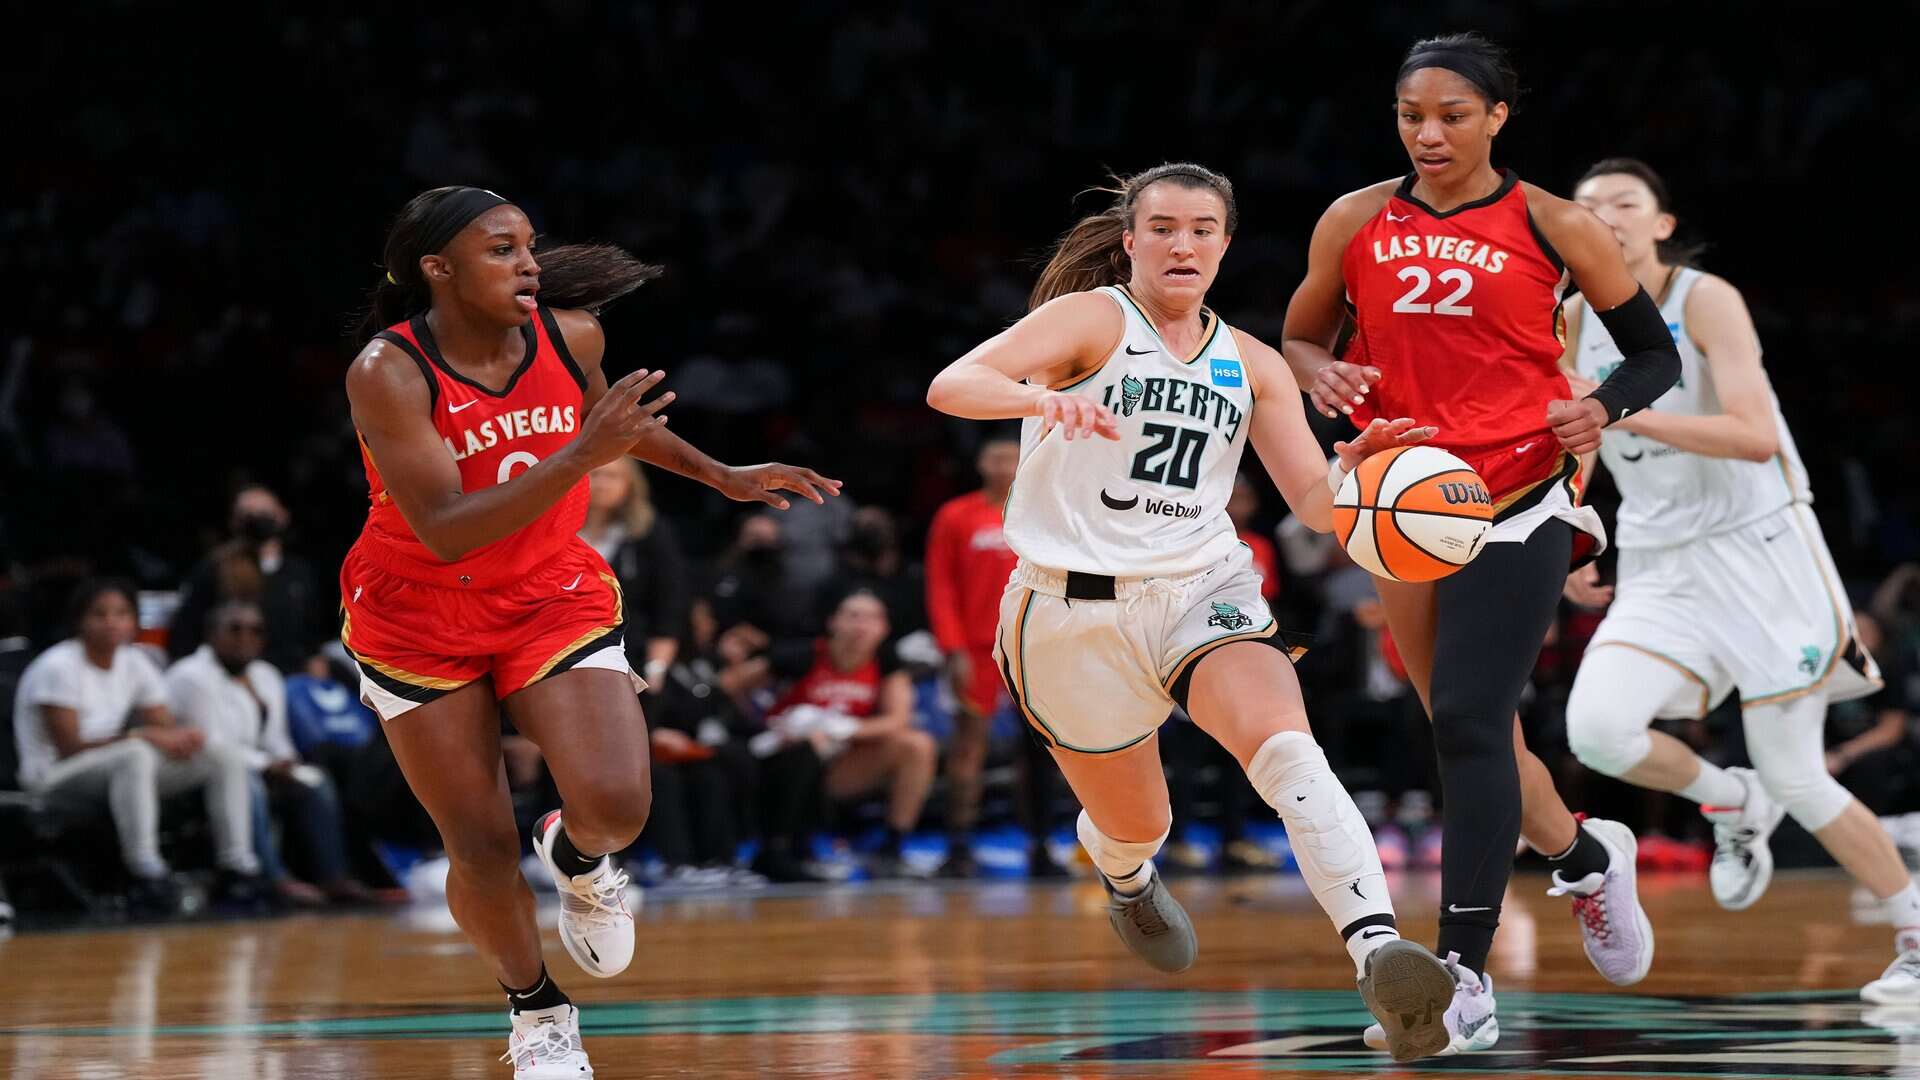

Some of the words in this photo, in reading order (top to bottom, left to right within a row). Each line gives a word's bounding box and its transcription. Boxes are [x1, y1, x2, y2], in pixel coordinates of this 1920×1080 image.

[1373, 235, 1421, 264] LAS
[1425, 235, 1510, 274] VEGAS
[1392, 265, 1473, 317] 22
[1213, 367, 1241, 379] HSS
[444, 420, 498, 461] LAS
[495, 405, 575, 440] VEGAS
[1130, 422, 1209, 490] 20
[1145, 498, 1202, 519] Webull
